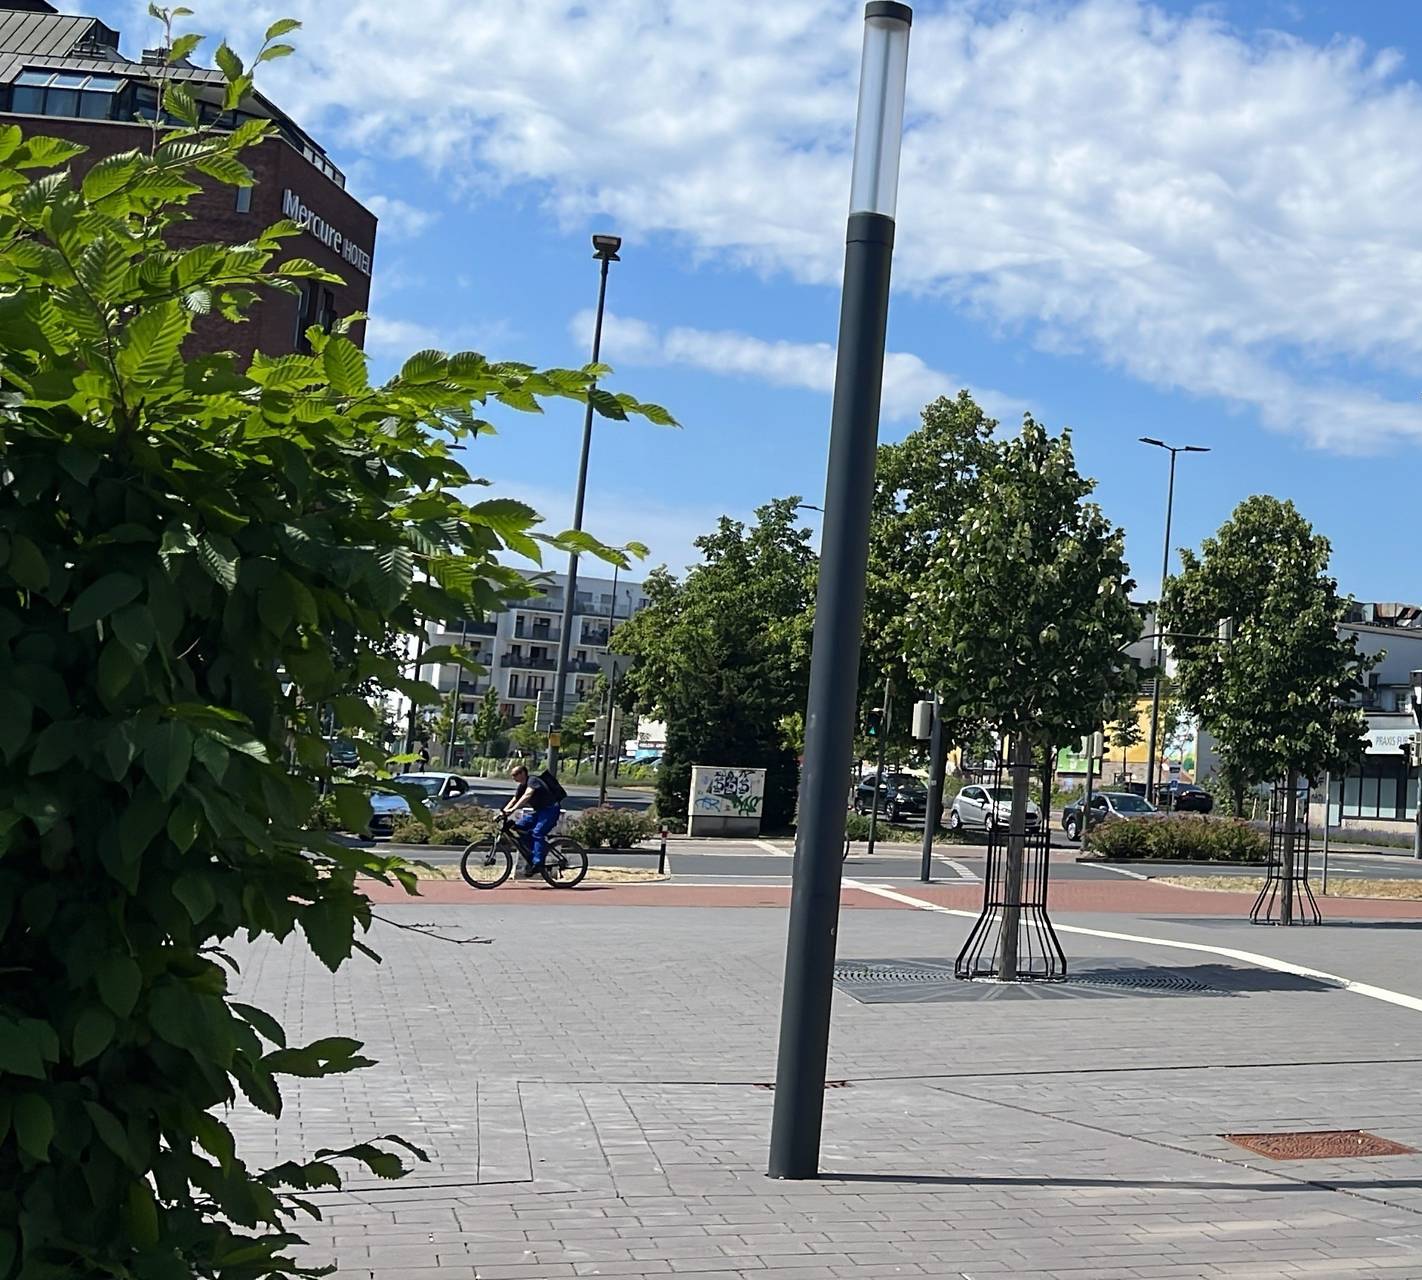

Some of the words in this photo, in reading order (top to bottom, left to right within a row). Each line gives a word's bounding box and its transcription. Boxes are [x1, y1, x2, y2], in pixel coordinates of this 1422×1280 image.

[282, 188, 342, 253] Mercure
[341, 237, 371, 277] HOTEL
[1376, 735, 1396, 746] PRAXIS
